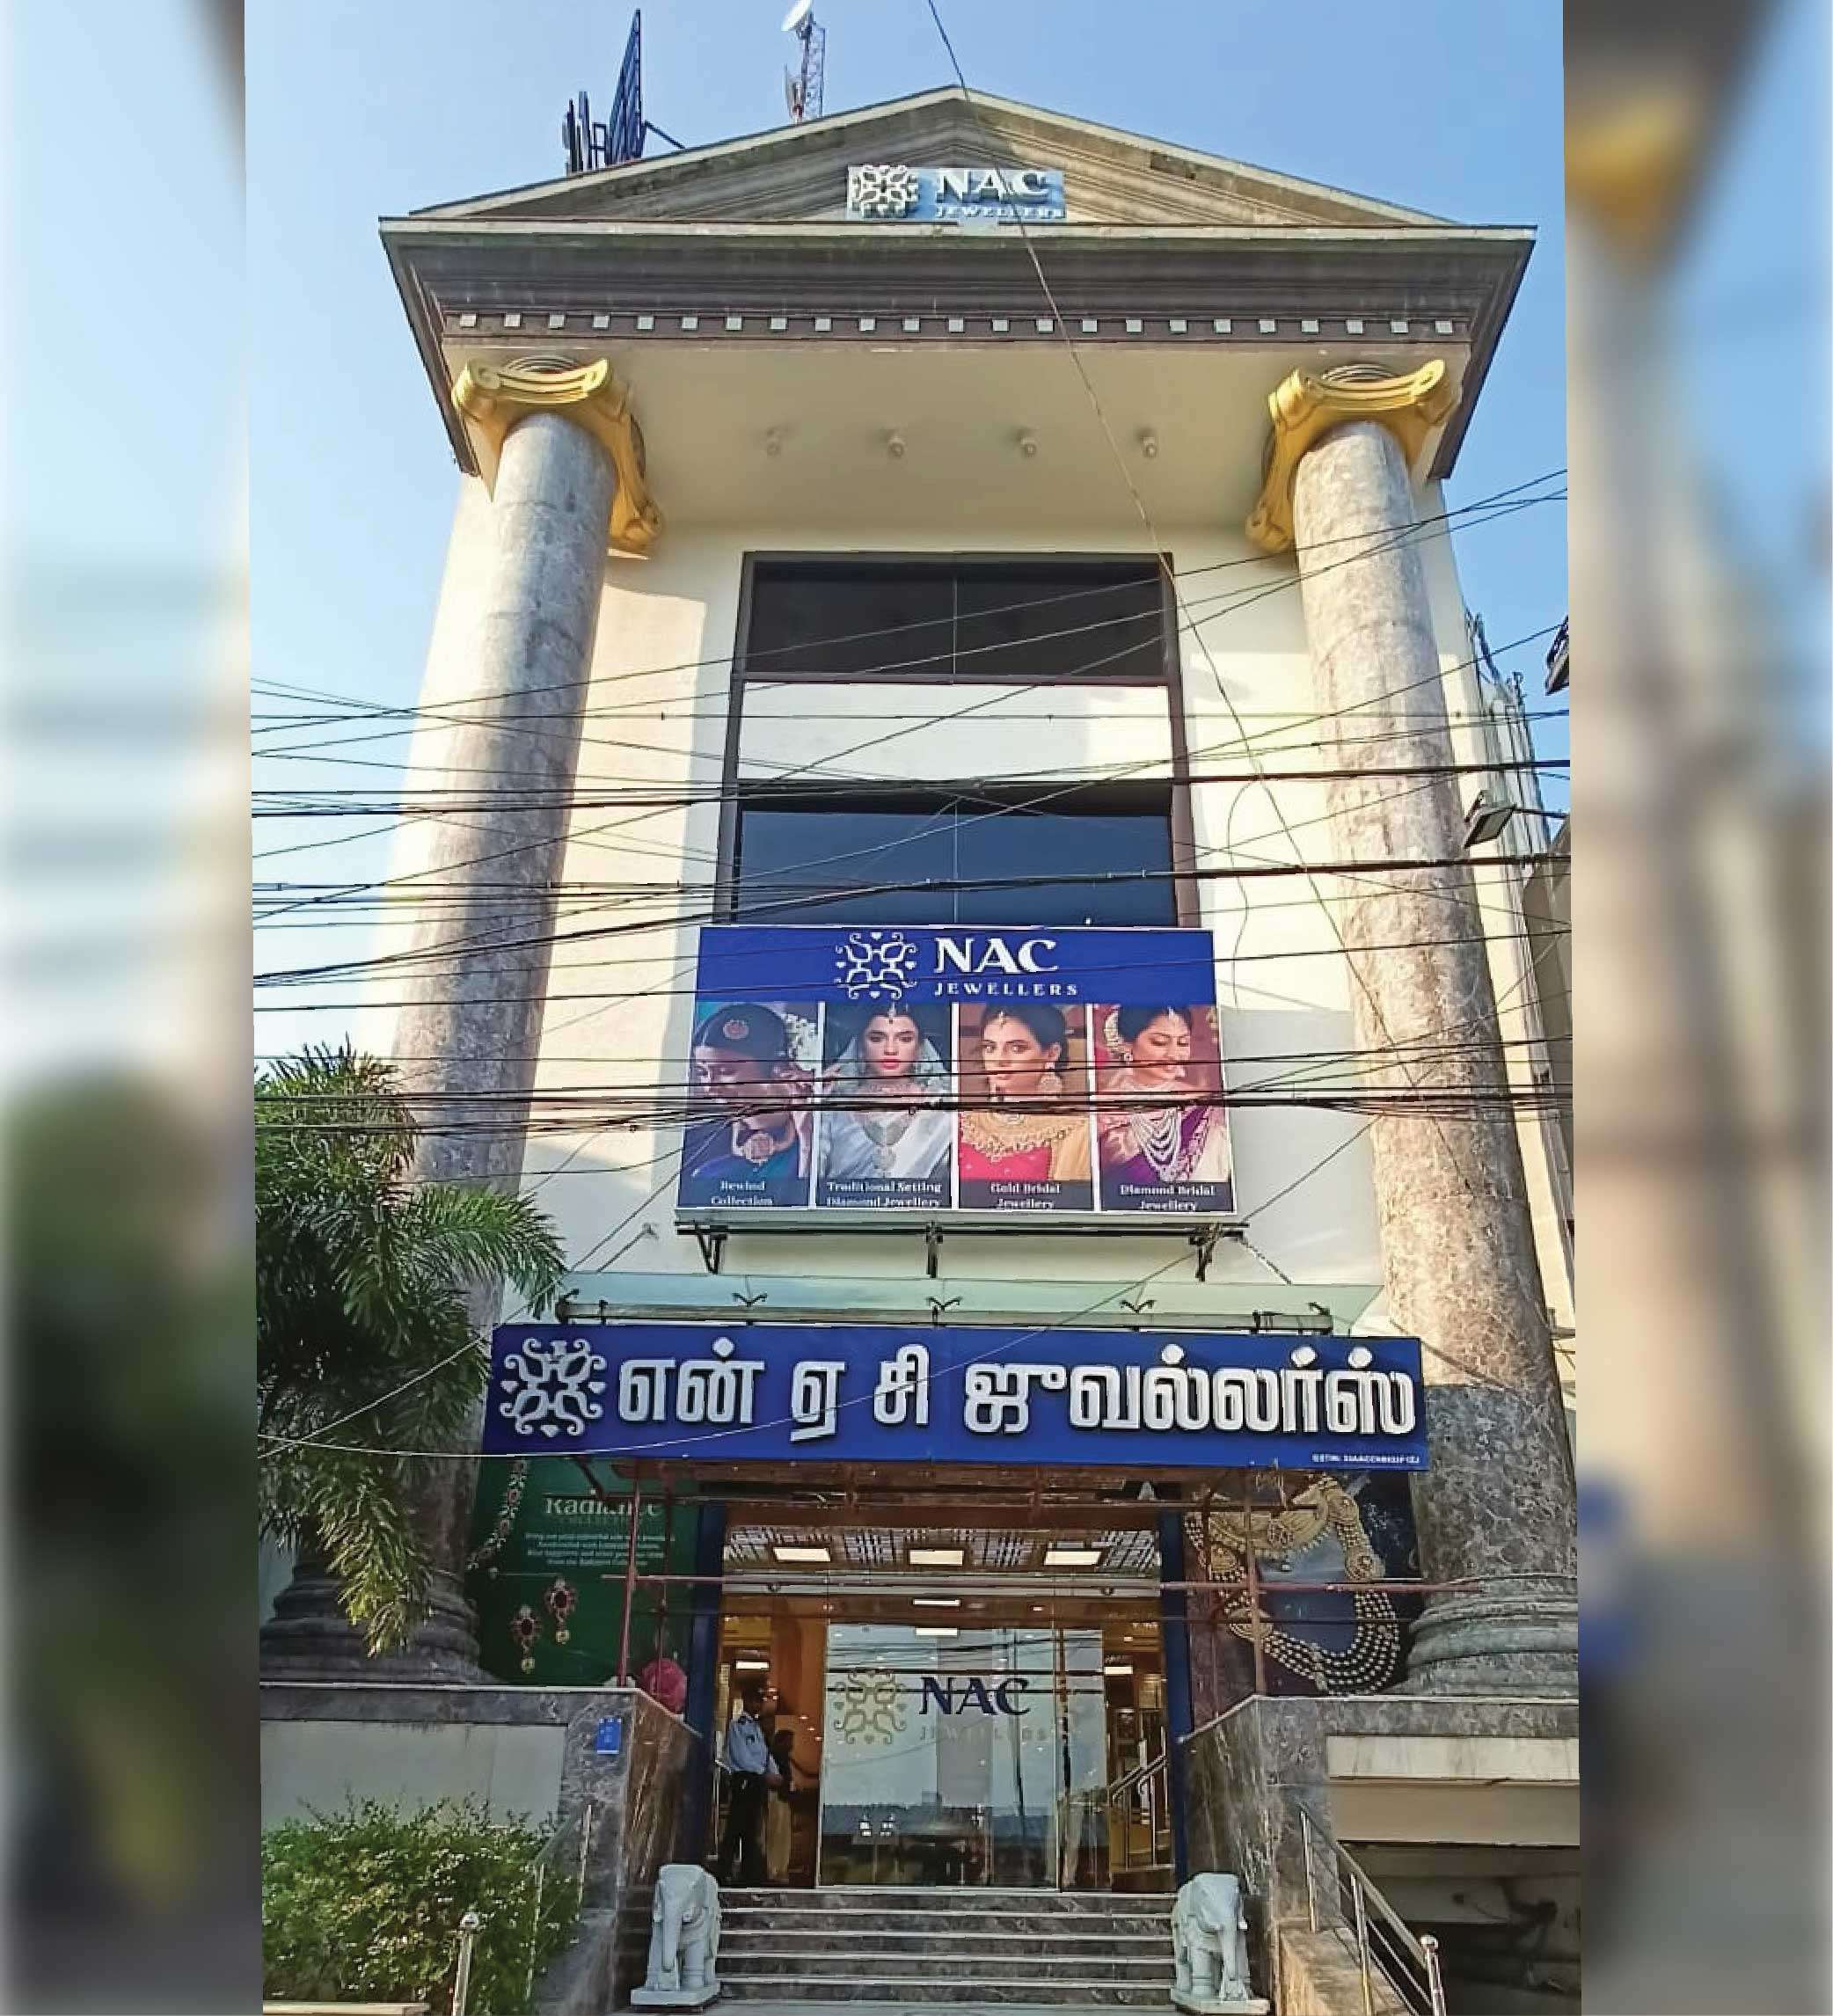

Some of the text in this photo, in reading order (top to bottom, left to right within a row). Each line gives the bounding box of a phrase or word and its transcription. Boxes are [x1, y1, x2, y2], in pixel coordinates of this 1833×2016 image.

[936, 170, 1049, 202] NAC
[934, 937, 1059, 975] NAC
[934, 982, 1078, 997] JEWELLERS
[619, 1336, 1415, 1442] என் ஏ சி ஜுவல்லர்ஸ்
[918, 1676, 1030, 1716] NAC
